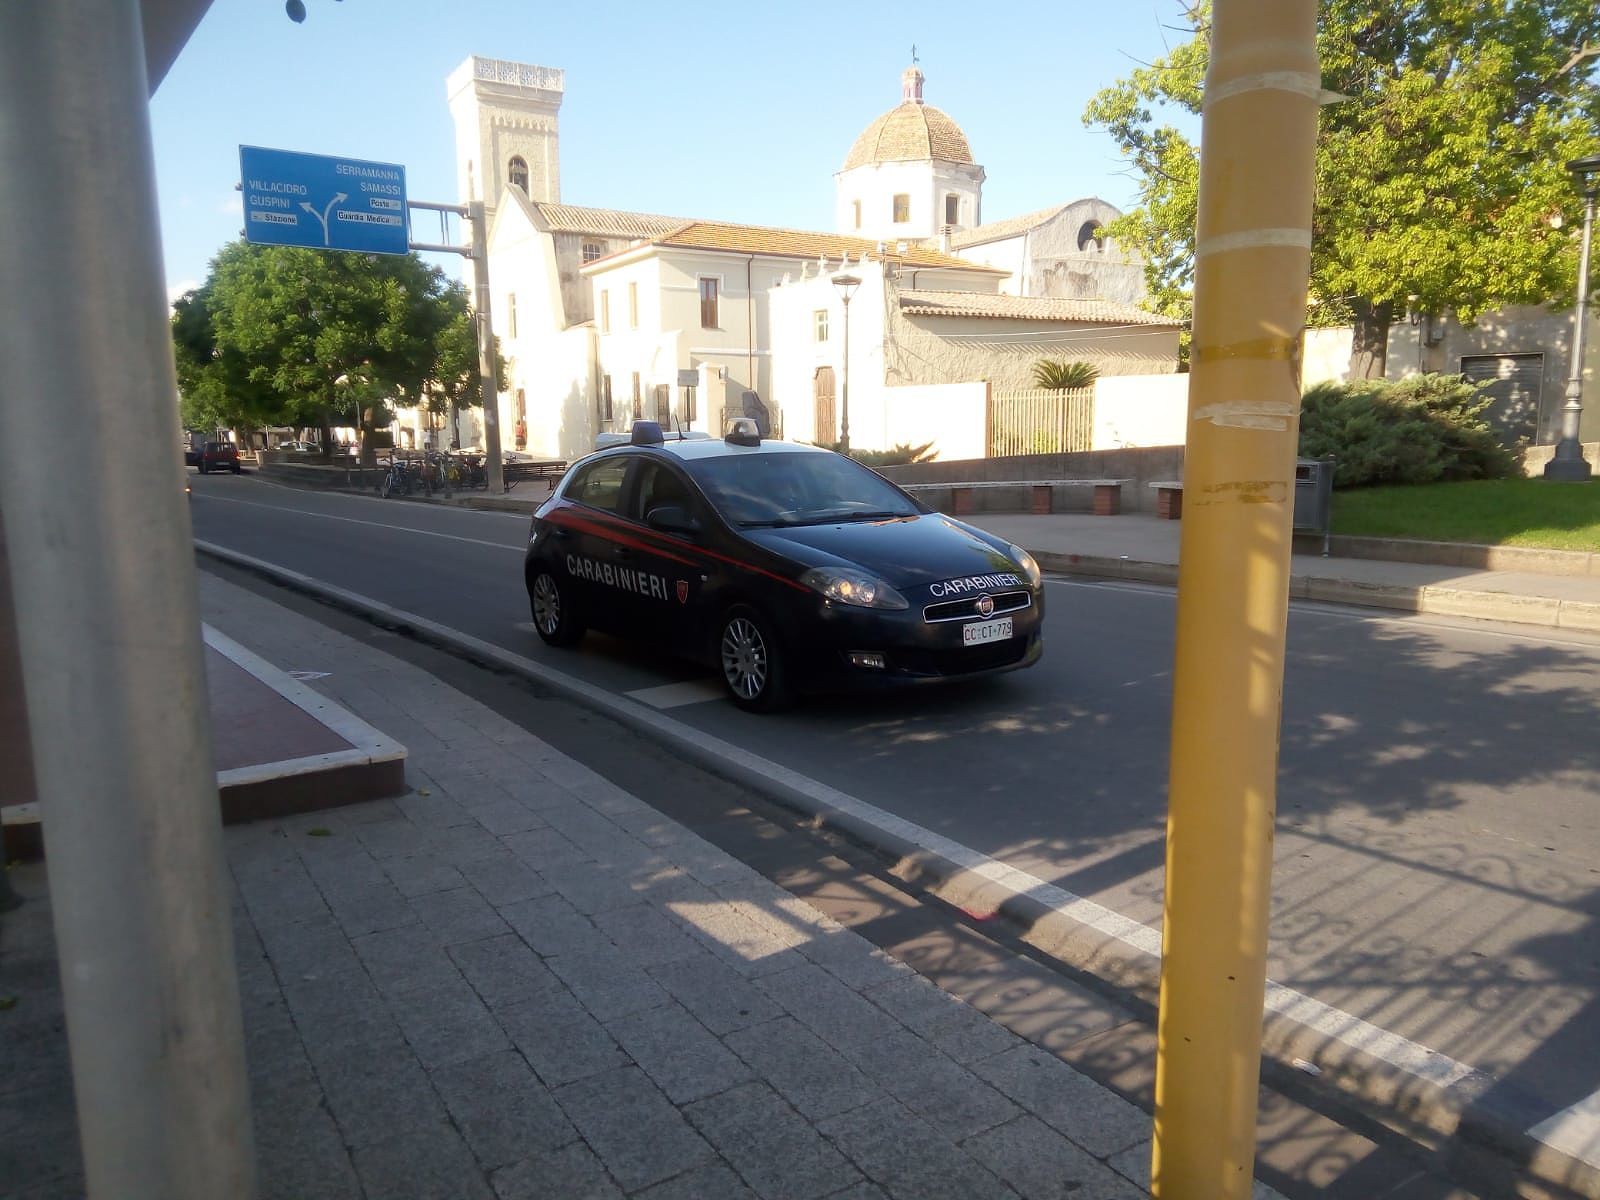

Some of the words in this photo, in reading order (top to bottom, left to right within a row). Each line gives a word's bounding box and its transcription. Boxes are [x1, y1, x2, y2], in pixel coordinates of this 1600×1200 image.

[336, 164, 400, 180] SERRAMANNA
[249, 179, 307, 195] VILLACIDRO
[360, 182, 401, 196] SAMASSI
[250, 194, 290, 209] GUSPINI
[264, 213, 297, 224] Stazione
[566, 554, 669, 601] CARABINIERI
[930, 574, 1022, 597] CARABINIERI
